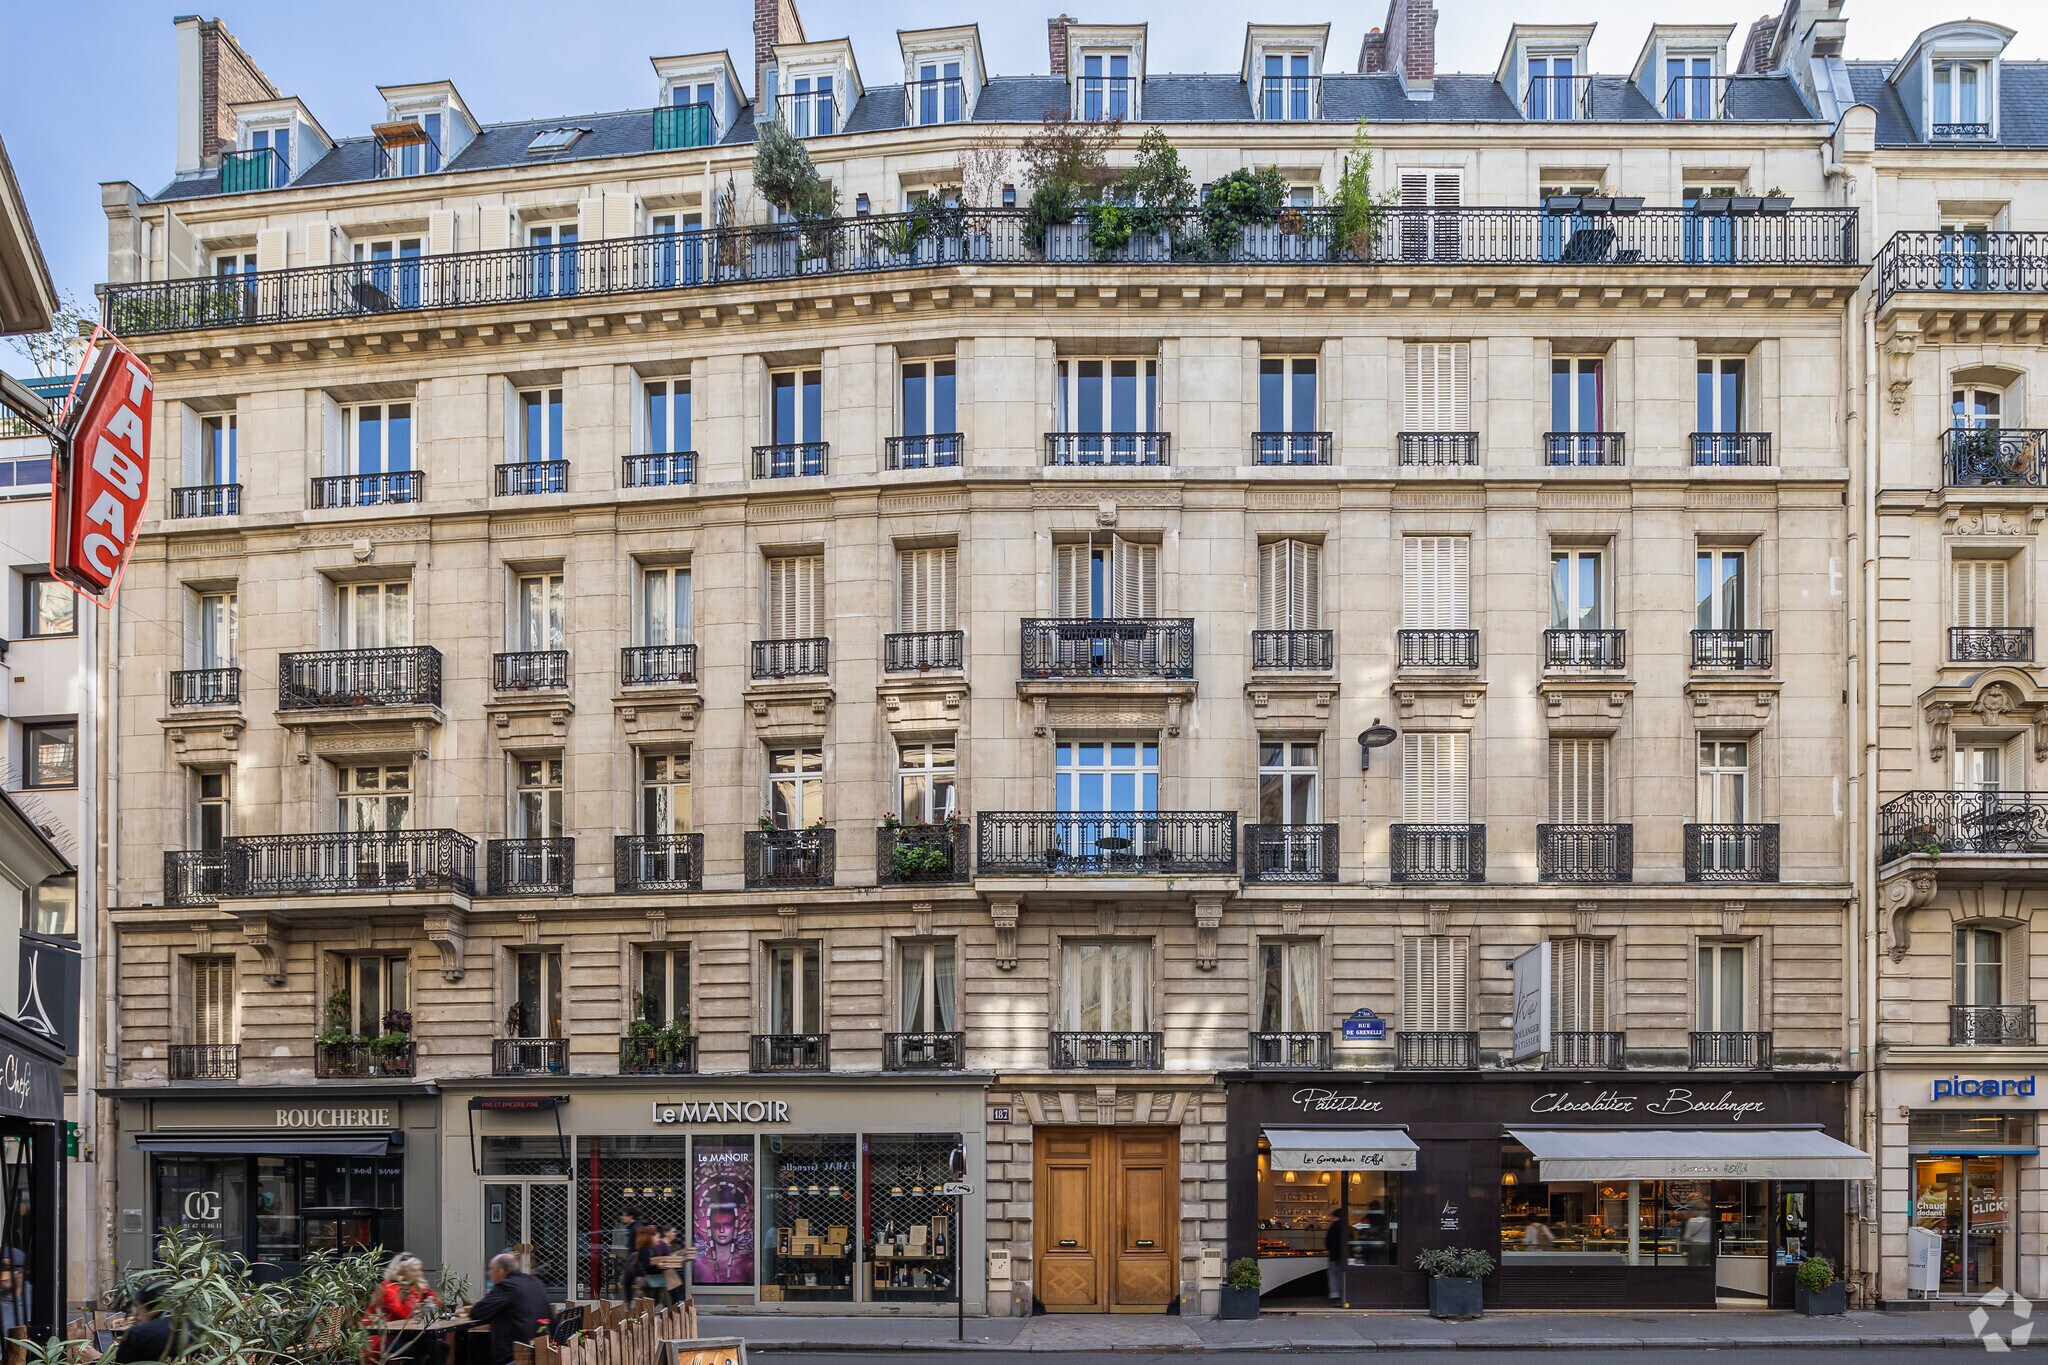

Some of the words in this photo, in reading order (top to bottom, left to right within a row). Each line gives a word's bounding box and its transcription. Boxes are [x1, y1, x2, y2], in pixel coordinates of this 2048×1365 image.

[83, 360, 153, 578] TABAC
[1514, 1023, 1540, 1041] BOULANGER
[1931, 1075, 2036, 1101] picard
[1292, 1088, 1383, 1112] Pâtissier
[1530, 1091, 1637, 1113] Chocolatier
[1646, 1088, 1765, 1121] Boulanger
[276, 1109, 389, 1127] BOUCHERIE
[652, 1101, 676, 1123] Le
[680, 1100, 790, 1122] MANOIR
[995, 1110, 1008, 1119] 187
[698, 1154, 707, 1162] Le
[710, 1153, 749, 1162] MANOIR
[1917, 1202, 1946, 1210] Chaud
[1972, 1201, 2004, 1214] CLICK
